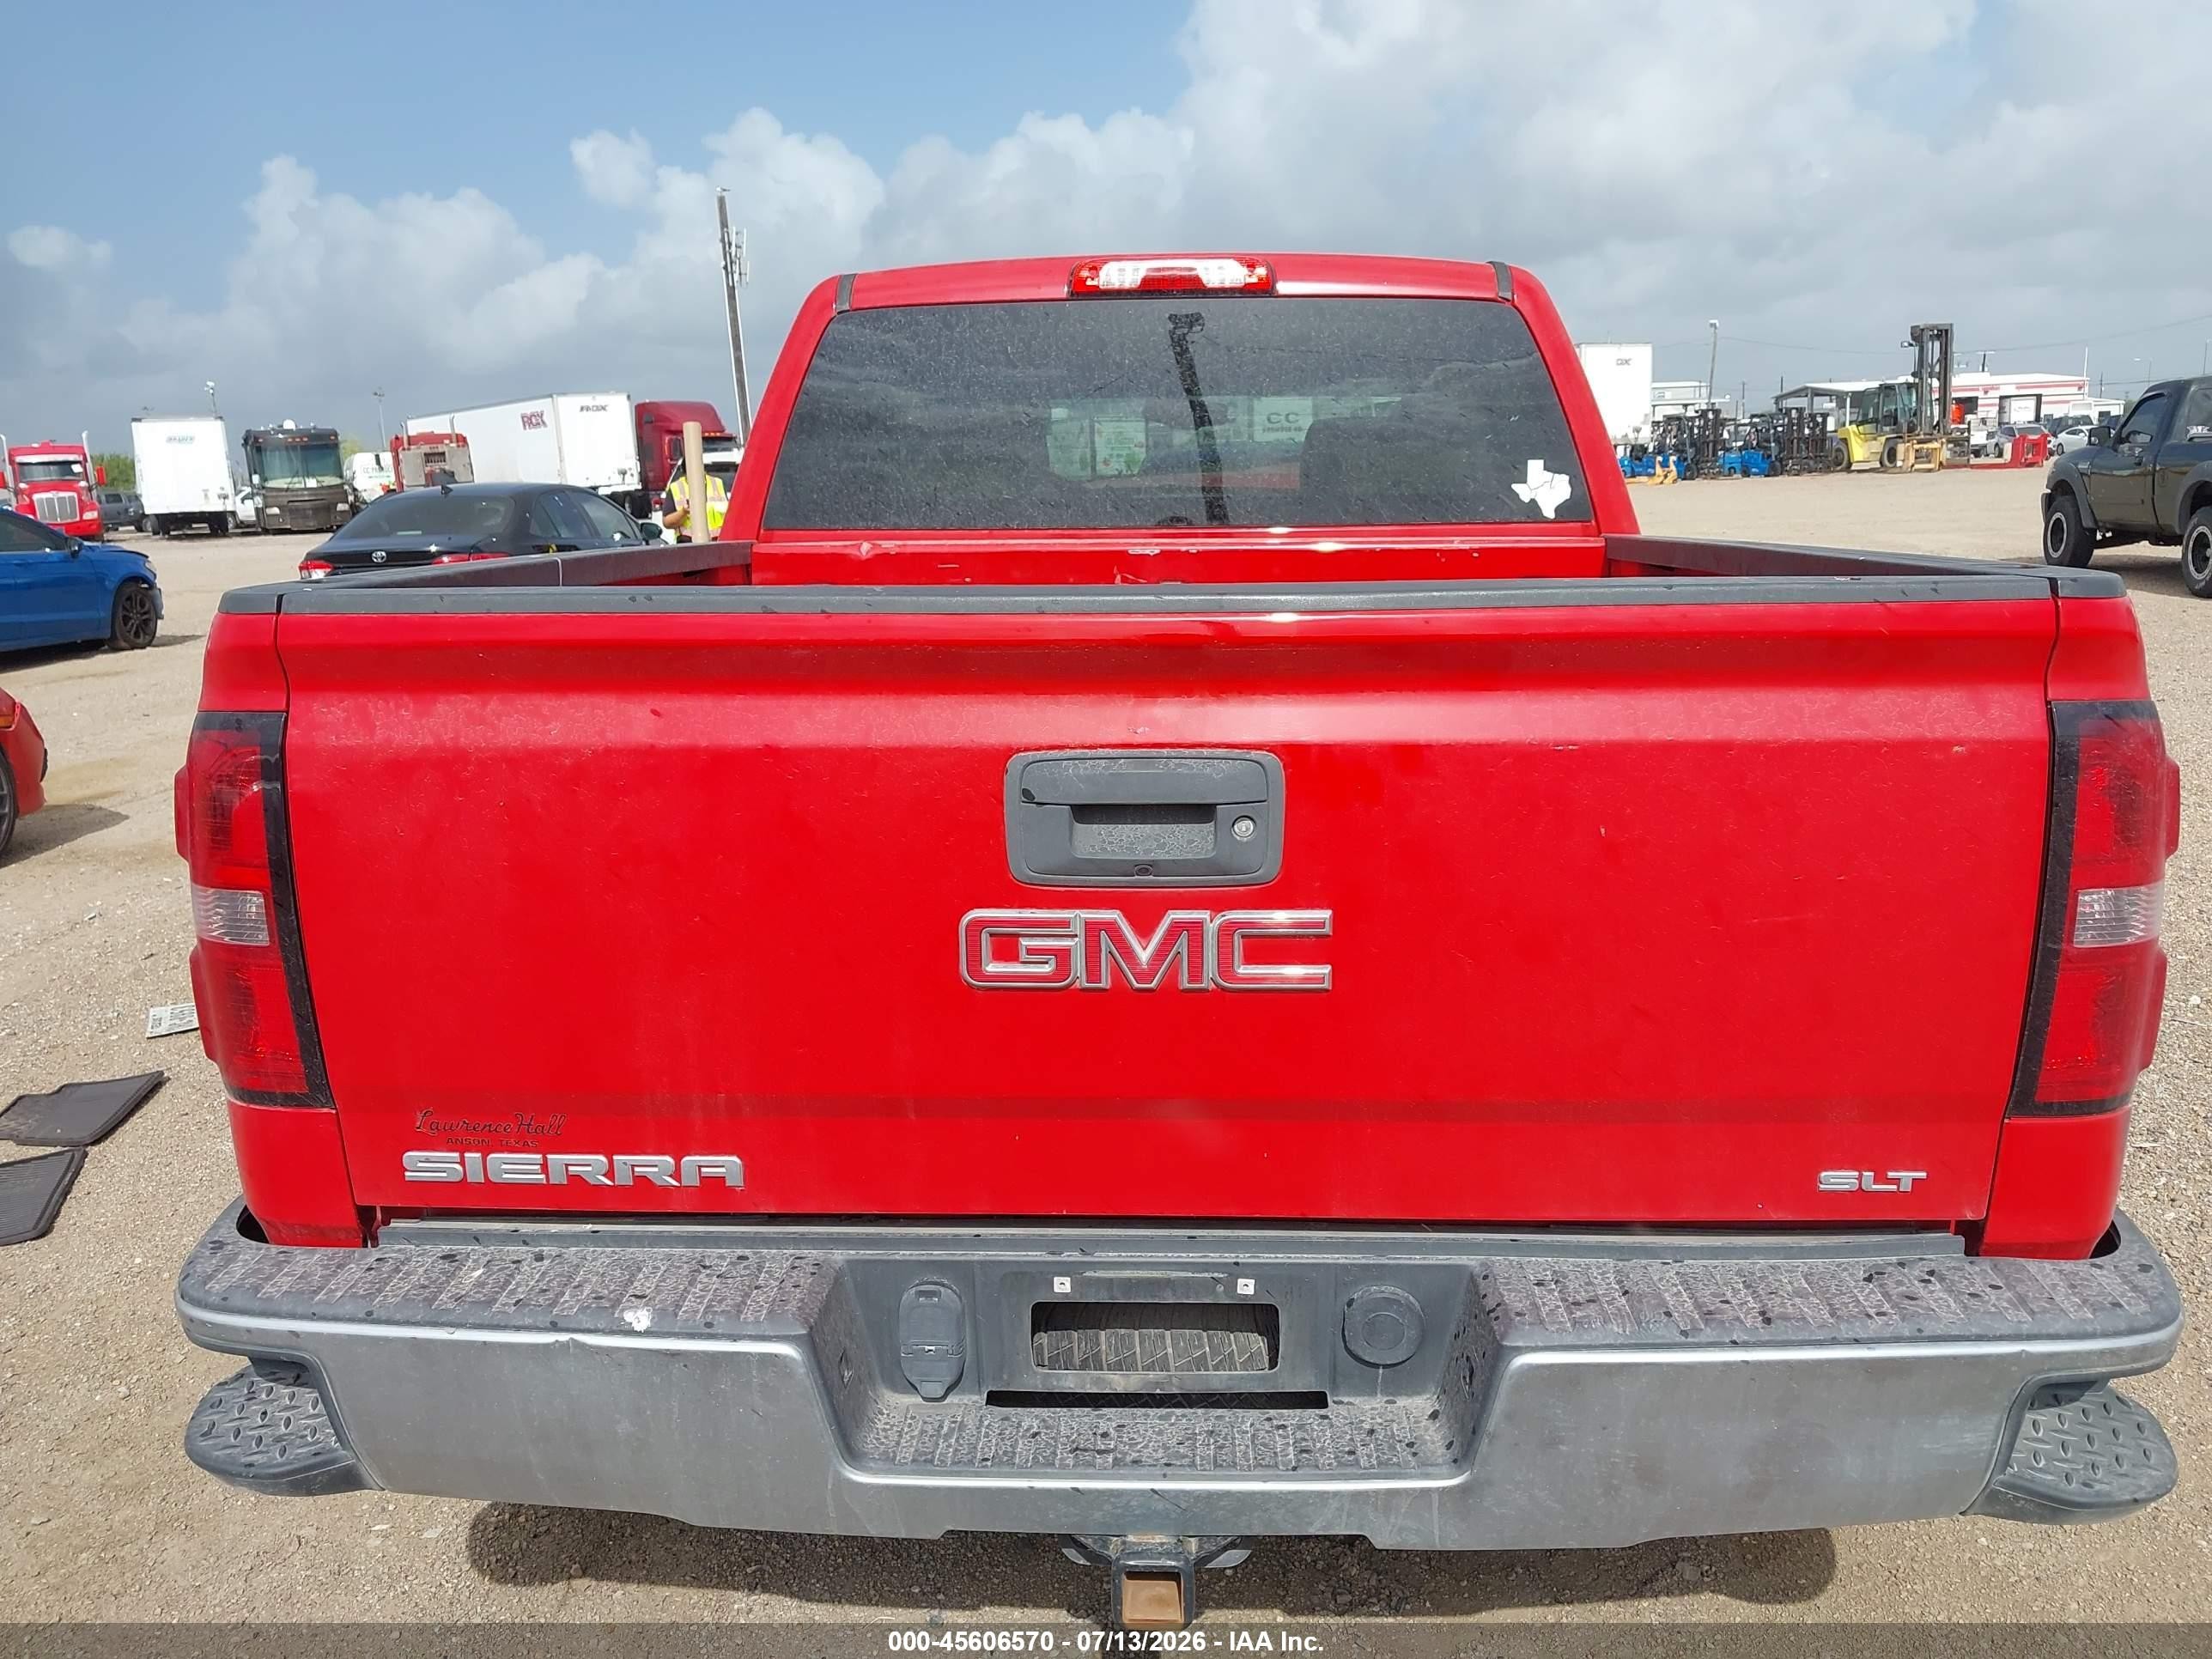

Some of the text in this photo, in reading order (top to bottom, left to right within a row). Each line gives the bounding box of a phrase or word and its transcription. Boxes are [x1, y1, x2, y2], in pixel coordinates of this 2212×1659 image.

[959, 909, 1332, 990] GMC
[416, 1109, 567, 1136] Lawrence Hall
[500, 1139, 538, 1148] TEXAS
[402, 1152, 744, 1188] SIERRA
[1818, 1171, 1928, 1192] SLT
